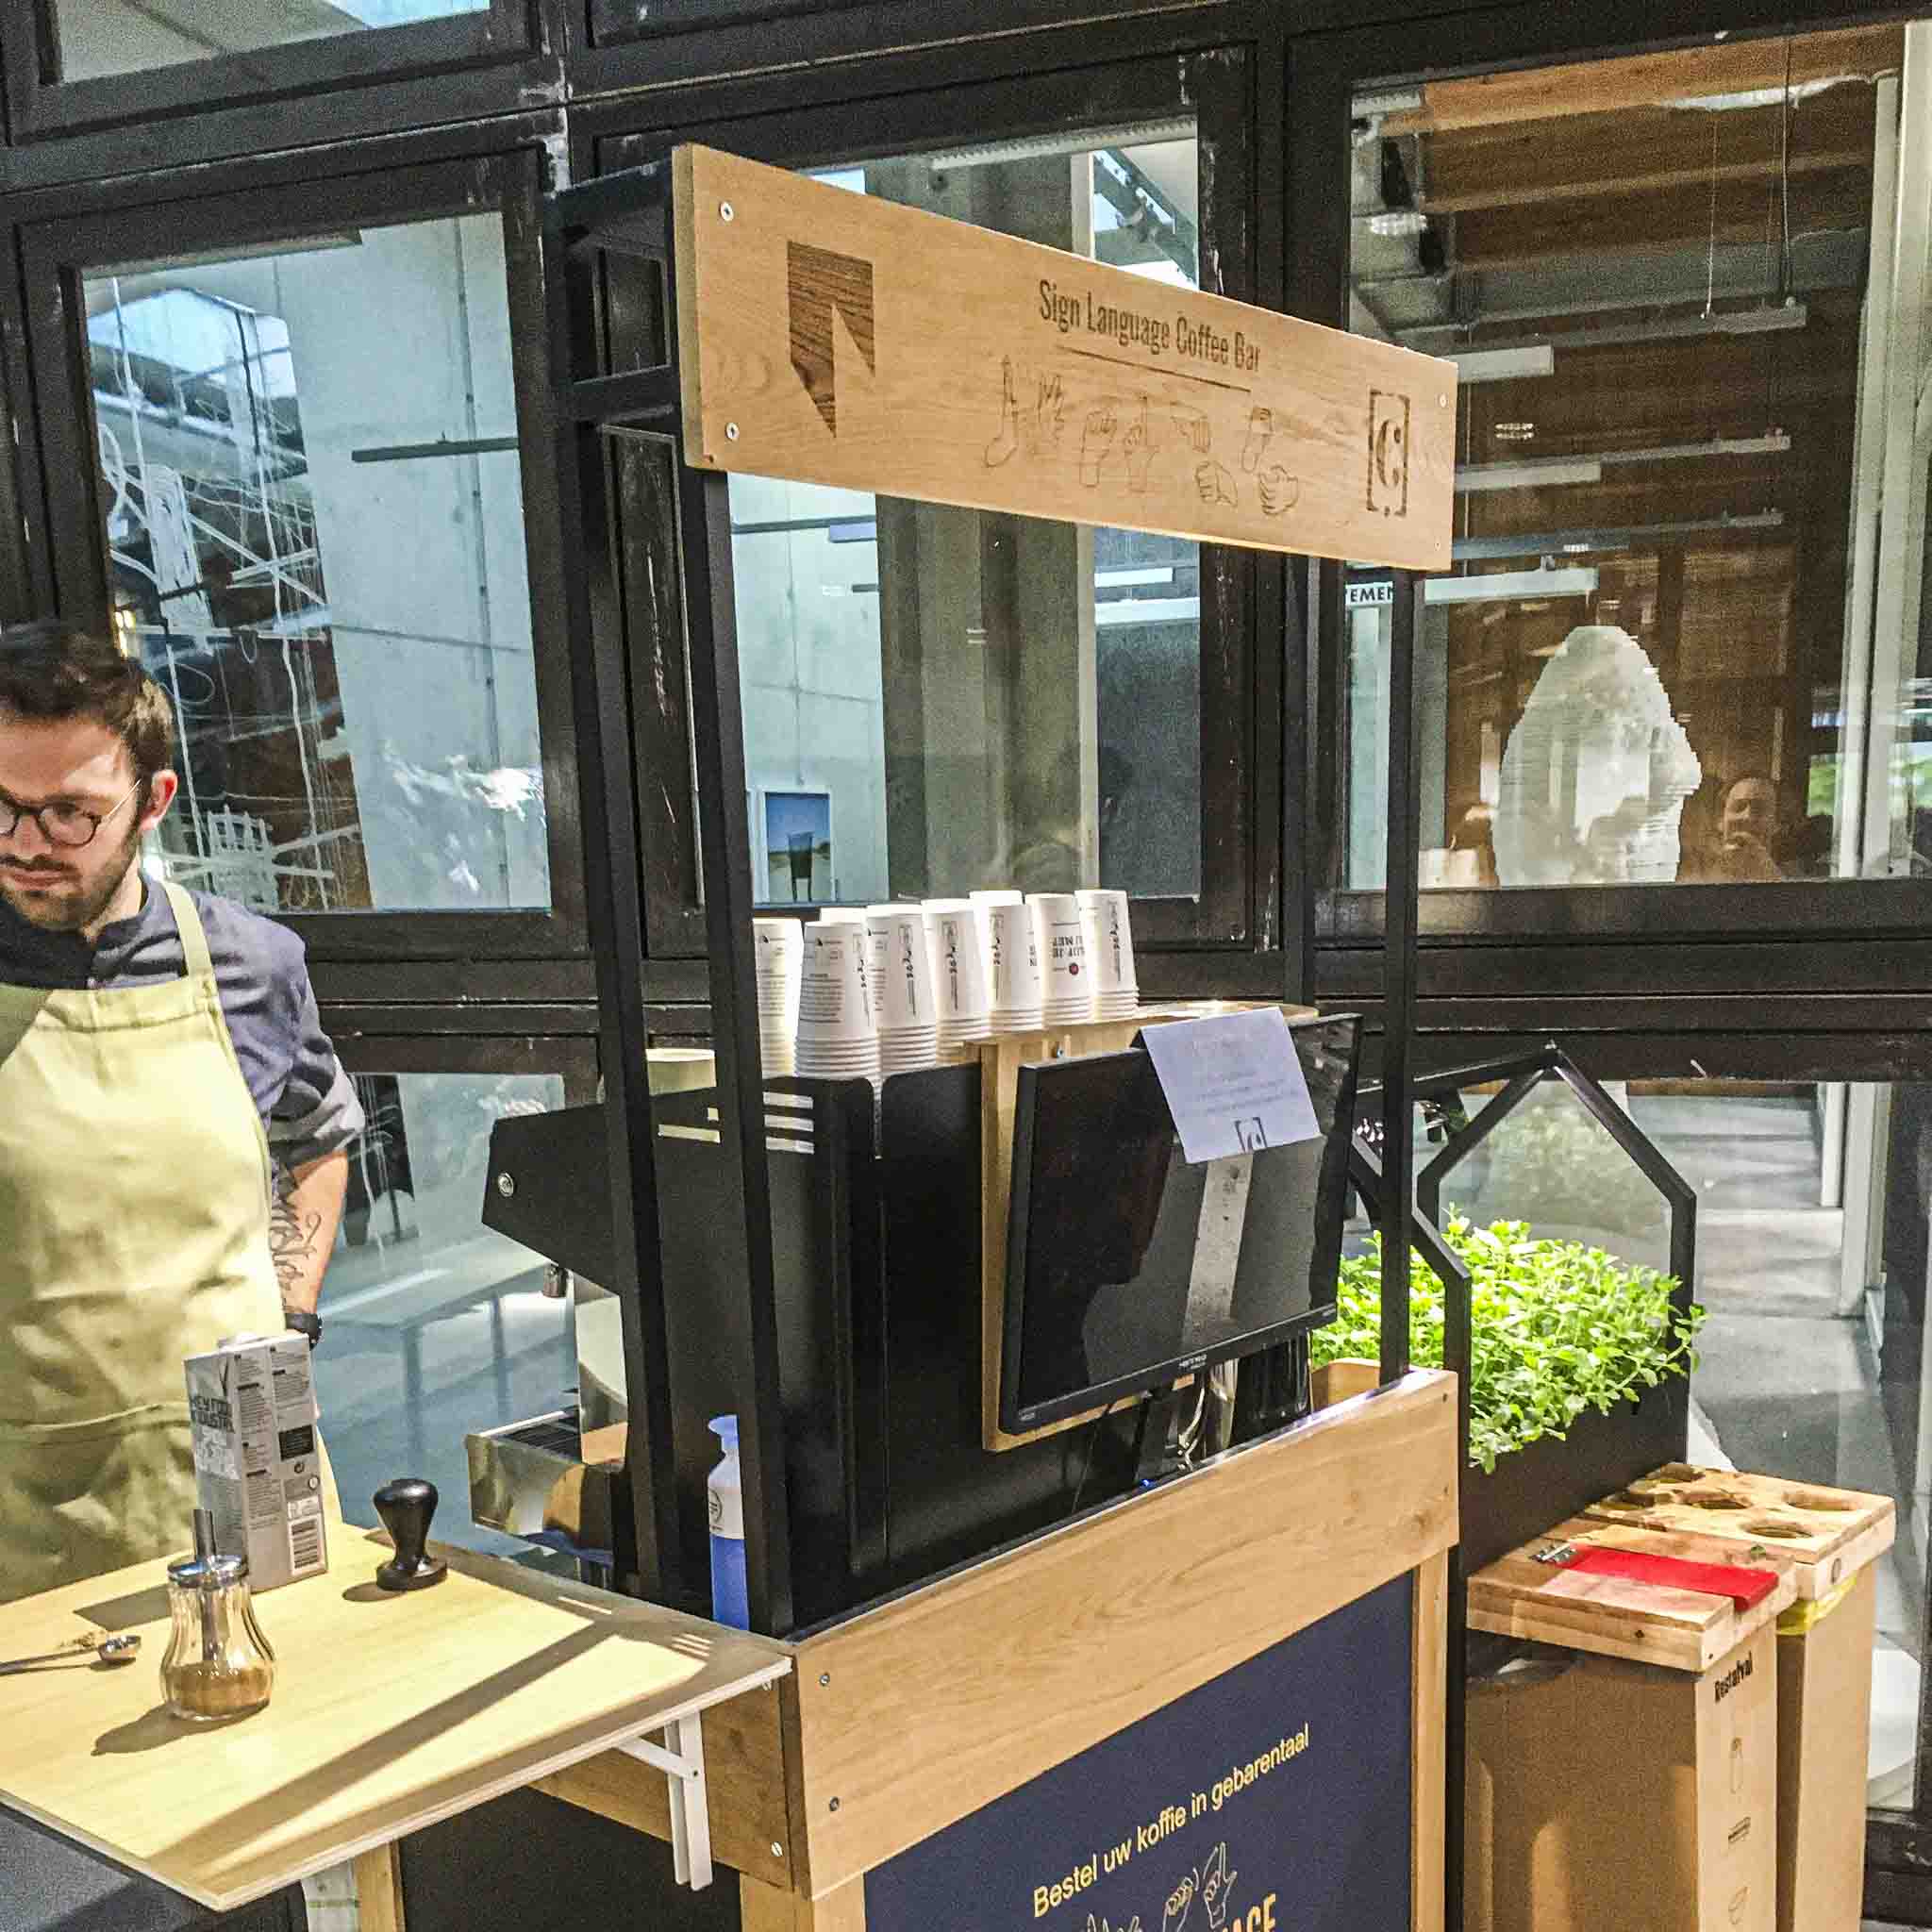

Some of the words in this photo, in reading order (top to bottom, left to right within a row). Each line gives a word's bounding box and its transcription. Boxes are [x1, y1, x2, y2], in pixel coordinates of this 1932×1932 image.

[1039, 279, 1080, 333] Sign
[1088, 291, 1170, 355] Language
[1176, 317, 1228, 365] Coffee
[1234, 332, 1261, 372] Bar
[1714, 1650, 1754, 1705] Restafval
[1034, 1853, 1098, 1918] Bestel
[1103, 1838, 1132, 1874] uw
[1137, 1804, 1186, 1853] koffie
[1191, 1791, 1207, 1820] in
[1211, 1722, 1309, 1811] gebarentaal
